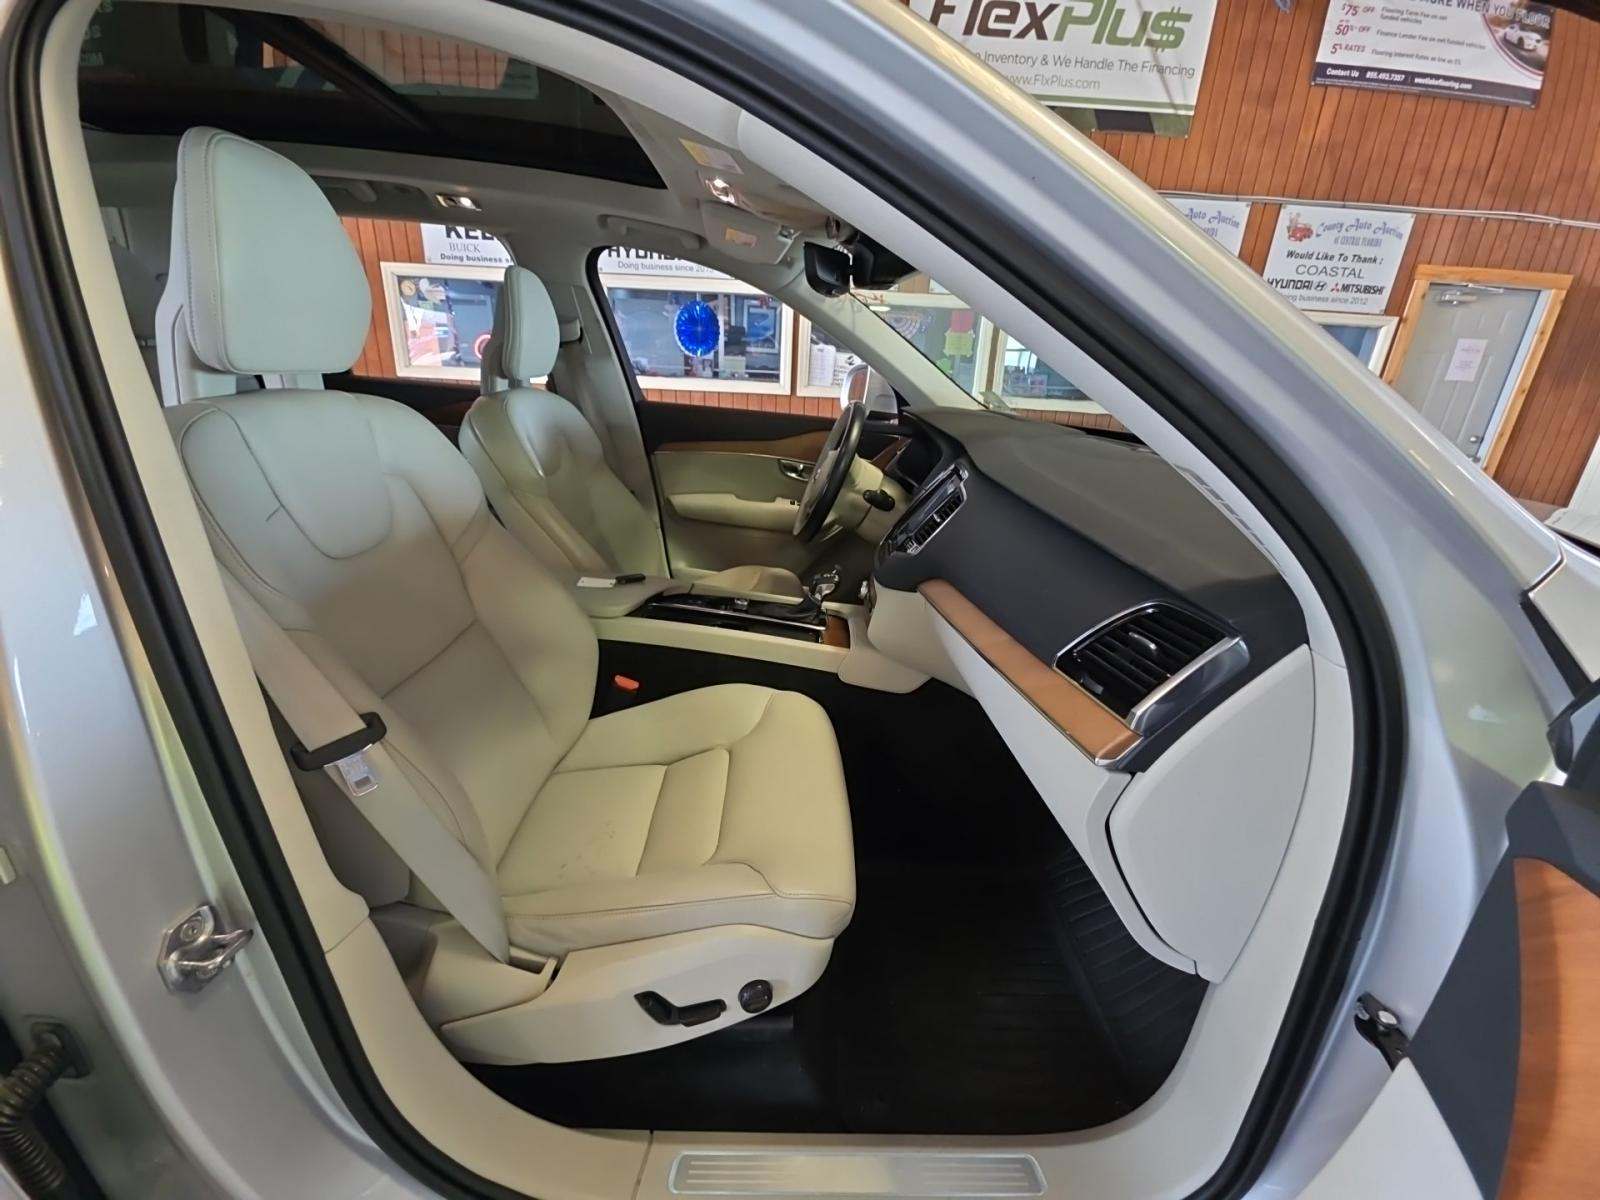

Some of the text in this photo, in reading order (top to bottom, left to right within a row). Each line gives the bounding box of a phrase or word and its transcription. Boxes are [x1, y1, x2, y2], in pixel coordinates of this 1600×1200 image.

[1456, 0, 1490, 13] WHEN
[1344, 44, 1366, 53] RATES
[984, 51, 1038, 67] Inventory
[1040, 55, 1049, 66] &
[1053, 56, 1071, 68] We
[1074, 57, 1114, 72] Handle
[1118, 60, 1137, 73] The
[1141, 61, 1195, 78] Financing
[1326, 67, 1351, 77] Contact
[1351, 70, 1360, 78] Us
[1345, 218, 1372, 233] Auto
[1373, 221, 1403, 241] Auction
[449, 242, 480, 253] BUICK
[441, 253, 463, 262] Doing
[466, 254, 502, 263] business
[1286, 250, 1314, 260] Would
[1316, 252, 1335, 261] Like
[1338, 253, 1348, 263] To
[1351, 254, 1377, 264] Thank
[618, 261, 639, 270] Doing
[641, 262, 673, 272] business
[675, 264, 694, 273] since
[1295, 264, 1365, 279] COASTAL
[1341, 284, 1385, 296] MITSUBISHI
[1299, 294, 1329, 303] business
[1331, 296, 1349, 304] since
[1350, 297, 1368, 305] 2012
